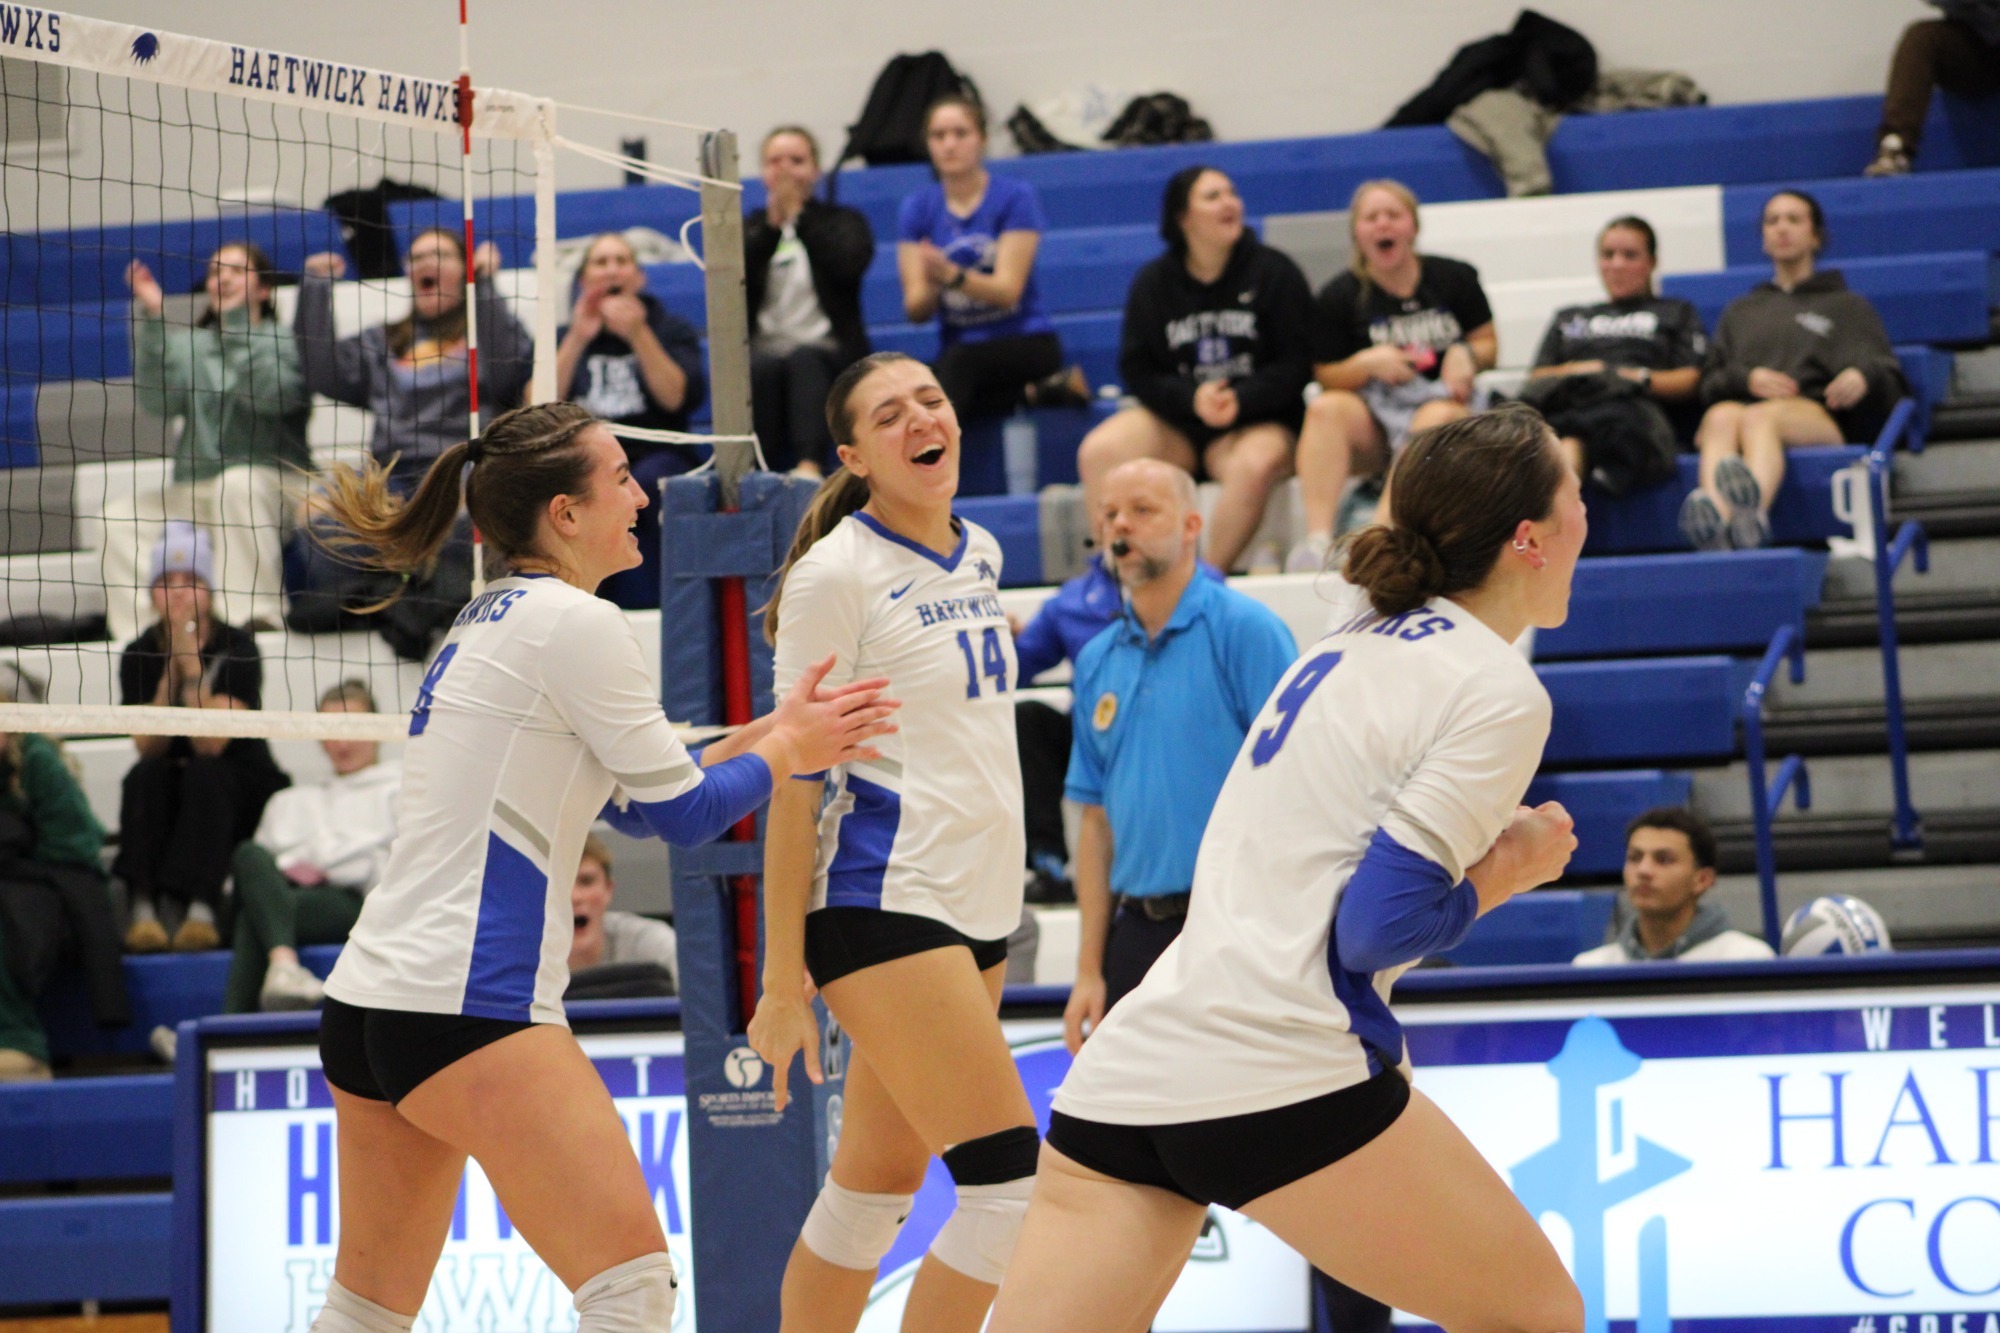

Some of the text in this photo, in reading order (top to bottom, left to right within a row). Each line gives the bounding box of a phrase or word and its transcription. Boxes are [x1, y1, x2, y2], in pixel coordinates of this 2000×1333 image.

[229, 46, 367, 107] HARTWICK
[956, 627, 1007, 699] 14
[1251, 651, 1344, 768] 9
[1862, 1004, 2000, 1050] WEL
[1838, 1195, 2000, 1298] CO
